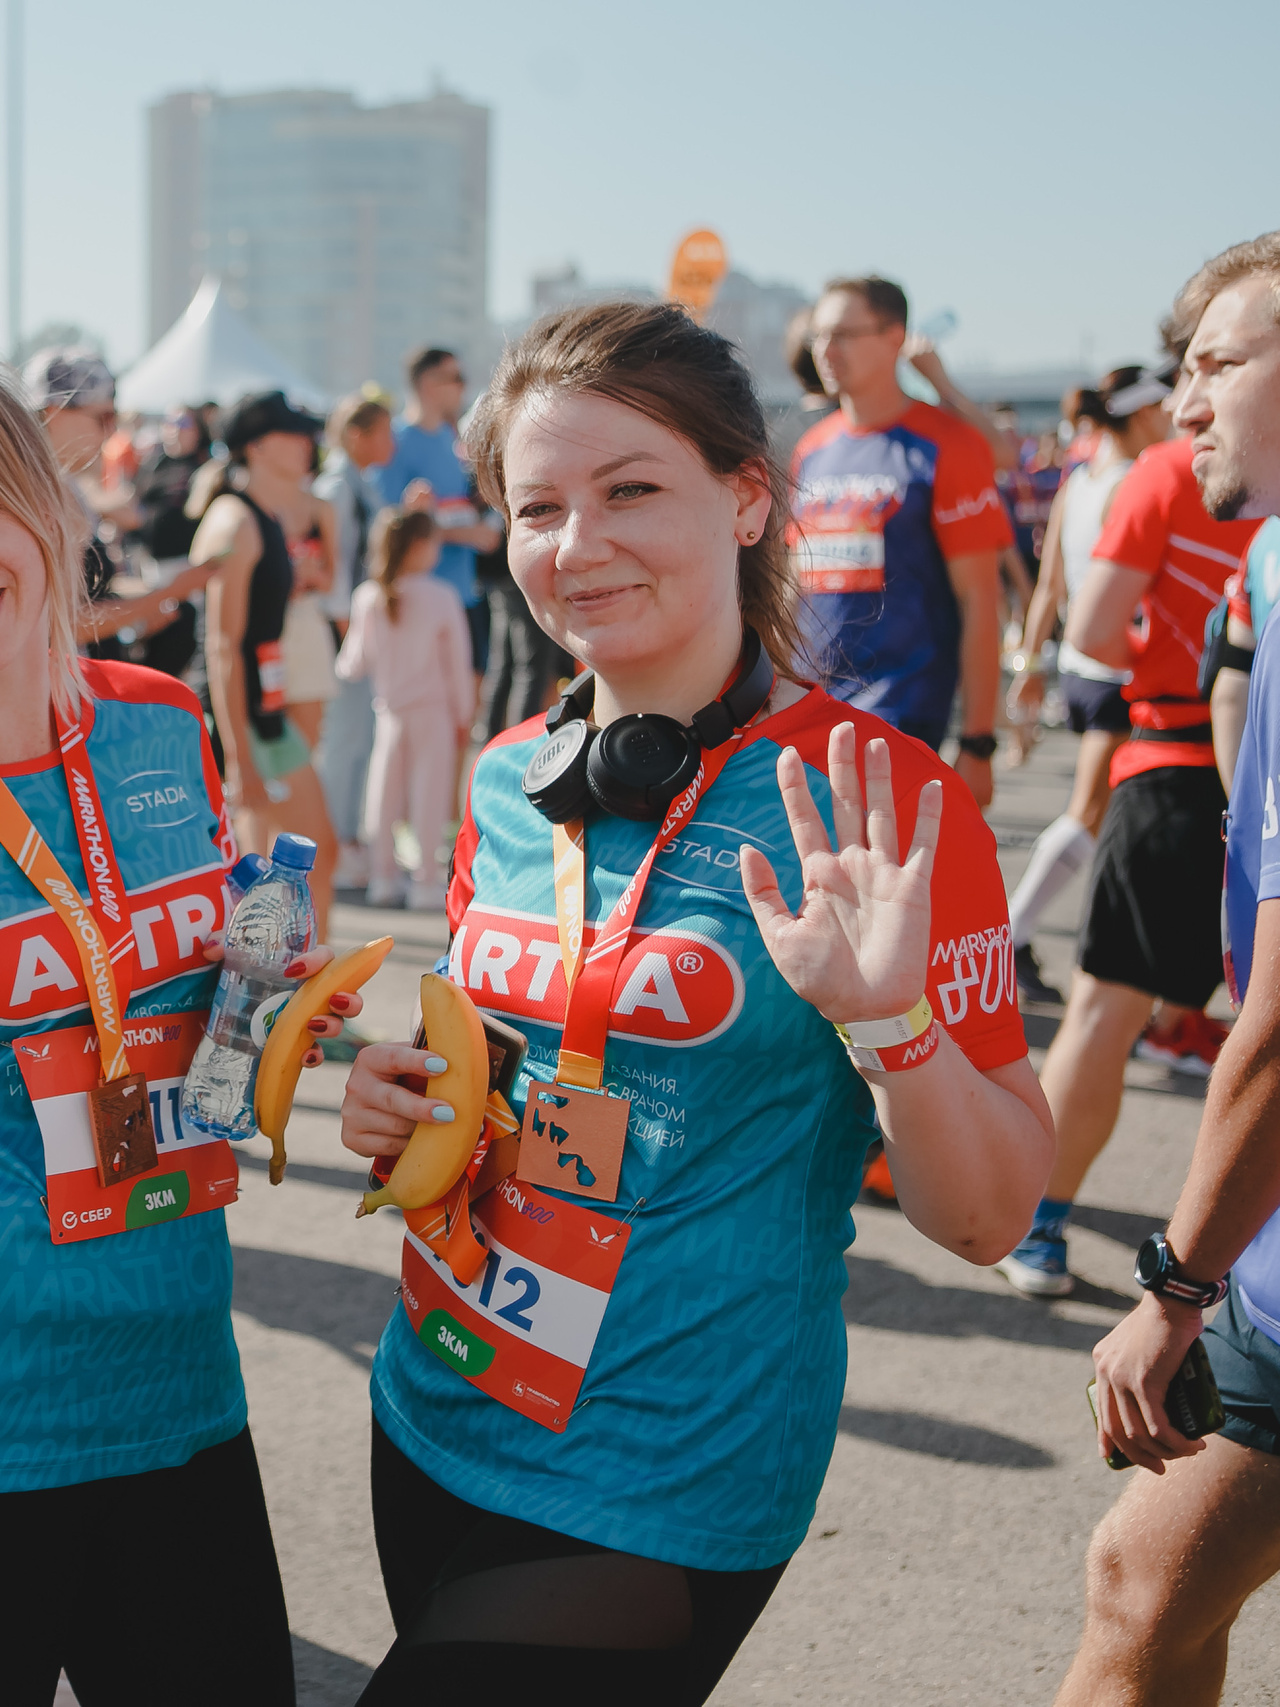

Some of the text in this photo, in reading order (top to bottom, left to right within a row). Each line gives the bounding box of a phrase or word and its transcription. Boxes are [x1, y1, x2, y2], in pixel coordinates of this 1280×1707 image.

[126, 786, 189, 813] STADA
[662, 838, 744, 870] STAD
[148, 1087, 185, 1145] 11
[79, 1207, 112, 1224] СБЕР
